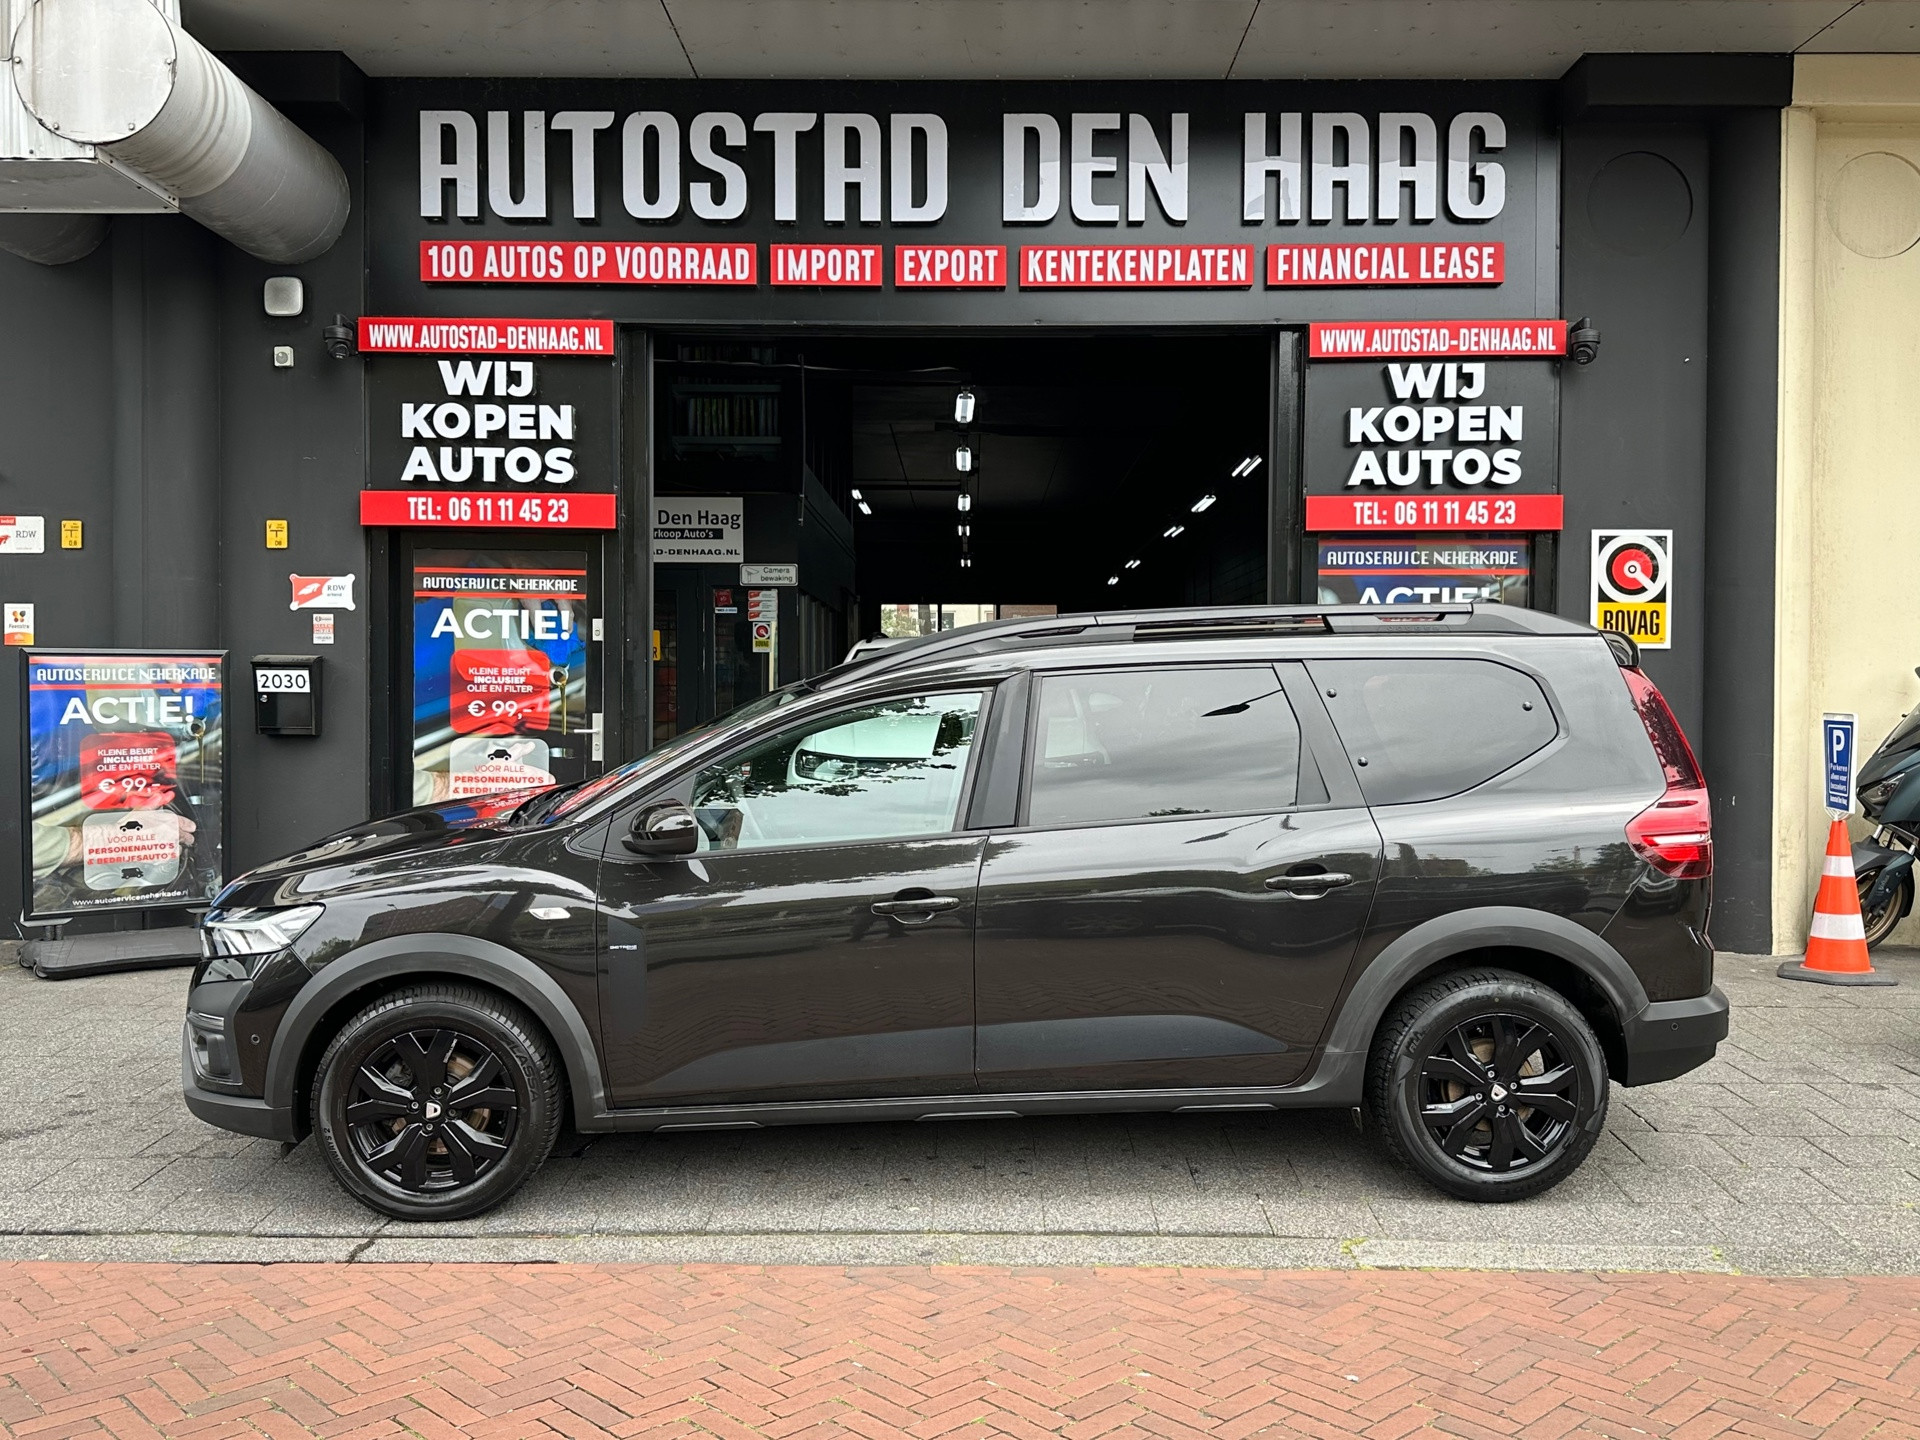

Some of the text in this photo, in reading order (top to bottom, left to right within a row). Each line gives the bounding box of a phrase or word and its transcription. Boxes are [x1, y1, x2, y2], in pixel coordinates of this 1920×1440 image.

[420, 110, 1507, 222] AUTOSTAD DEN HAAG
[428, 244, 750, 280] 100 AUTOS OP VOORRAAD
[777, 247, 875, 281] IMPORT
[904, 247, 998, 282] EXPORT
[1027, 248, 1247, 282] KENTEKENPLATEN
[1277, 246, 1495, 281] FINANCIAL LEASE
[369, 324, 603, 351] WWW.AUTOSTAD-DENHAAG.NL
[1320, 327, 1556, 353] WWW.AUTOSTAD-DENHAAG.NL
[437, 360, 534, 397] WIJ
[1387, 362, 1486, 399] WIJ
[401, 402, 574, 440] KOPEN
[1349, 405, 1523, 443] KOPEN
[400, 446, 575, 484] AUTOS
[1347, 448, 1522, 486] AUTOS
[407, 496, 569, 523] TEL: 06 11 11 45 23
[1353, 501, 1516, 525] TEL: 06 11 11 45 23
[658, 510, 741, 530] Den Haag
[15, 530, 37, 539] RDW
[683, 530, 714, 539] Auto's
[1327, 550, 1518, 565] AUTOSERVICE NEHERKADE
[327, 584, 347, 592] RDW
[423, 576, 578, 592] AUTOSERVICE NEHERKADE
[760, 574, 793, 583] bewaking
[430, 608, 570, 640] ACTIE!
[1603, 610, 1660, 636] BOVAG
[37, 667, 216, 682] AUTOSERVICE NEHERKADE
[260, 673, 306, 689] 2030
[468, 667, 531, 675] KLEINE BEURT
[474, 676, 527, 684] INCLUSIEF
[467, 684, 533, 693] OLIE EN FILTER
[59, 696, 194, 725] ACTIE!
[468, 700, 532, 720] € 99,-
[1833, 729, 1845, 763] P
[97, 764, 117, 772] OLIE
[133, 763, 161, 771] FILTER
[103, 756, 155, 764] INCLUSIEF
[474, 765, 525, 773] VOOR ALLE
[98, 777, 161, 794] € 99,-
[454, 775, 544, 784] PERSONENAUTO'S
[107, 833, 156, 844] VOOR ALLE
[88, 842, 175, 856] PERSONENAUTO'S
[96, 851, 177, 865] BEDRIJFSAUTO'S
[72, 888, 189, 906] www.autoserviceneherkade.nl
